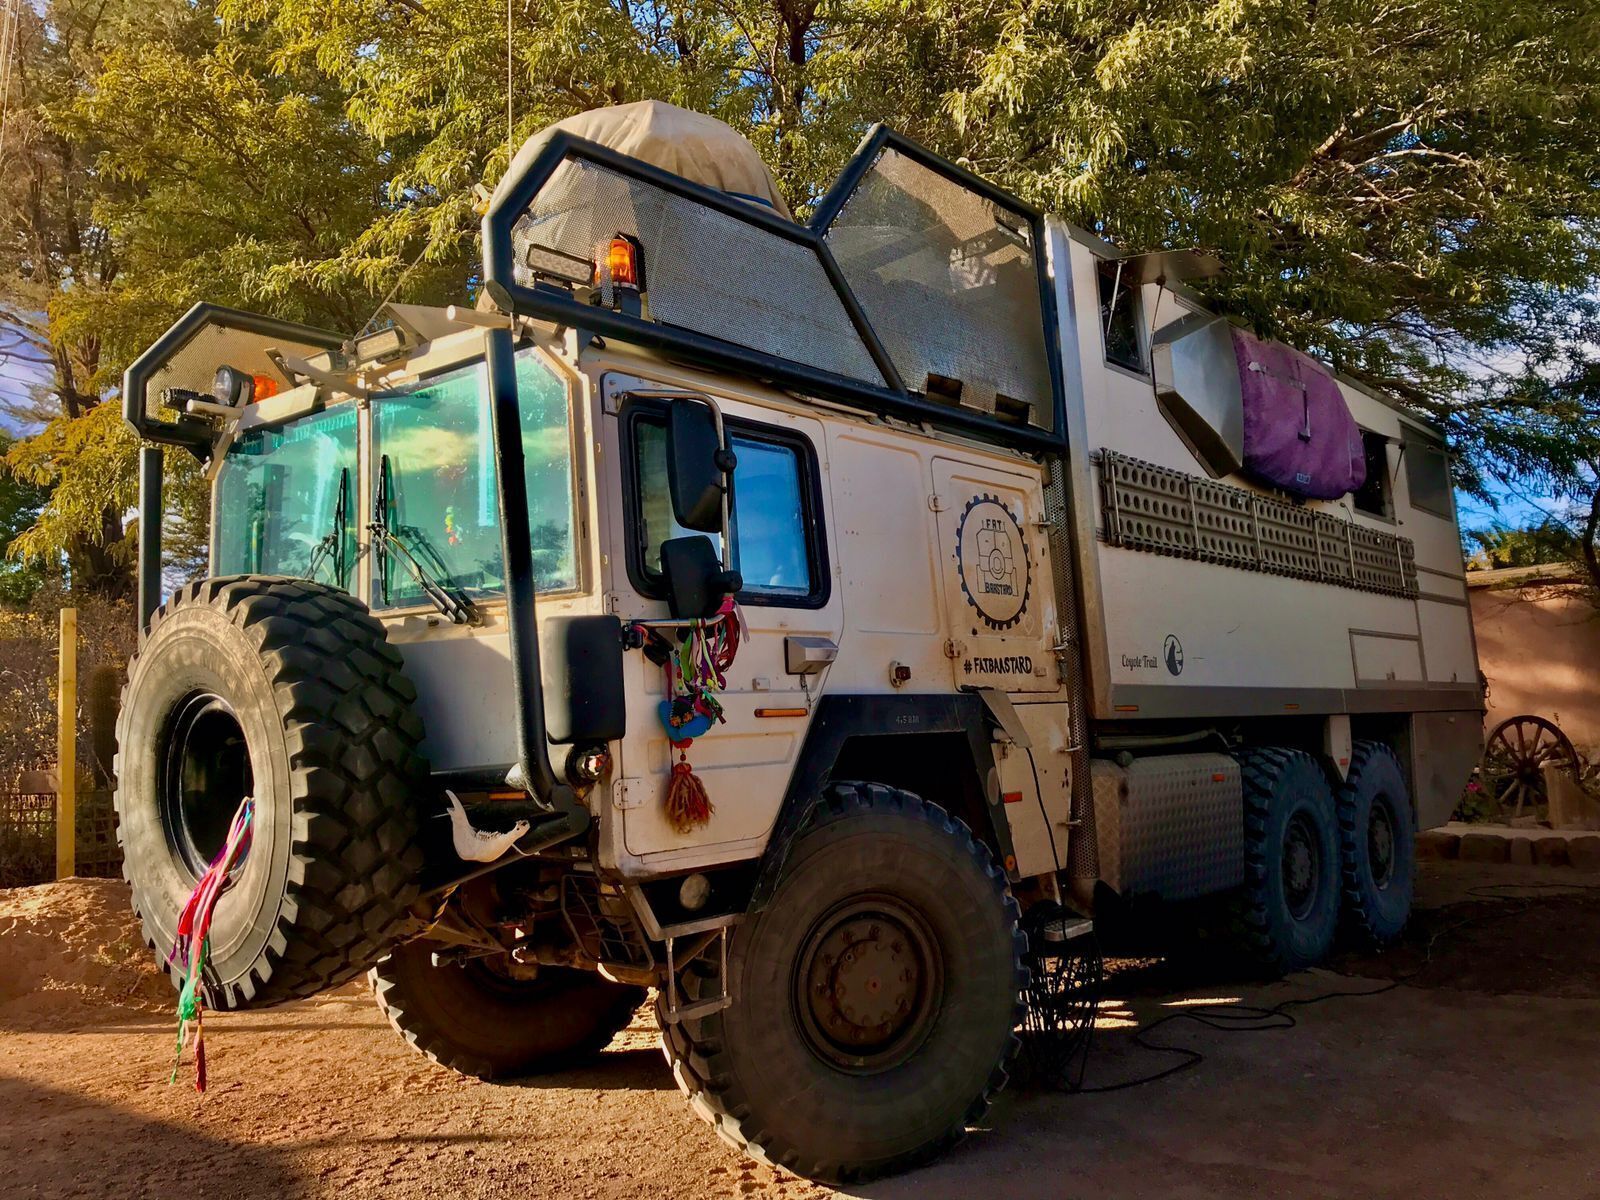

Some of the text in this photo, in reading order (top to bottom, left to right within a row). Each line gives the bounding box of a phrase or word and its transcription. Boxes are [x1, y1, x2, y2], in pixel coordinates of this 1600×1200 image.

[986, 519, 1002, 530] FAT
[1121, 653, 1158, 671] Coyote Trail
